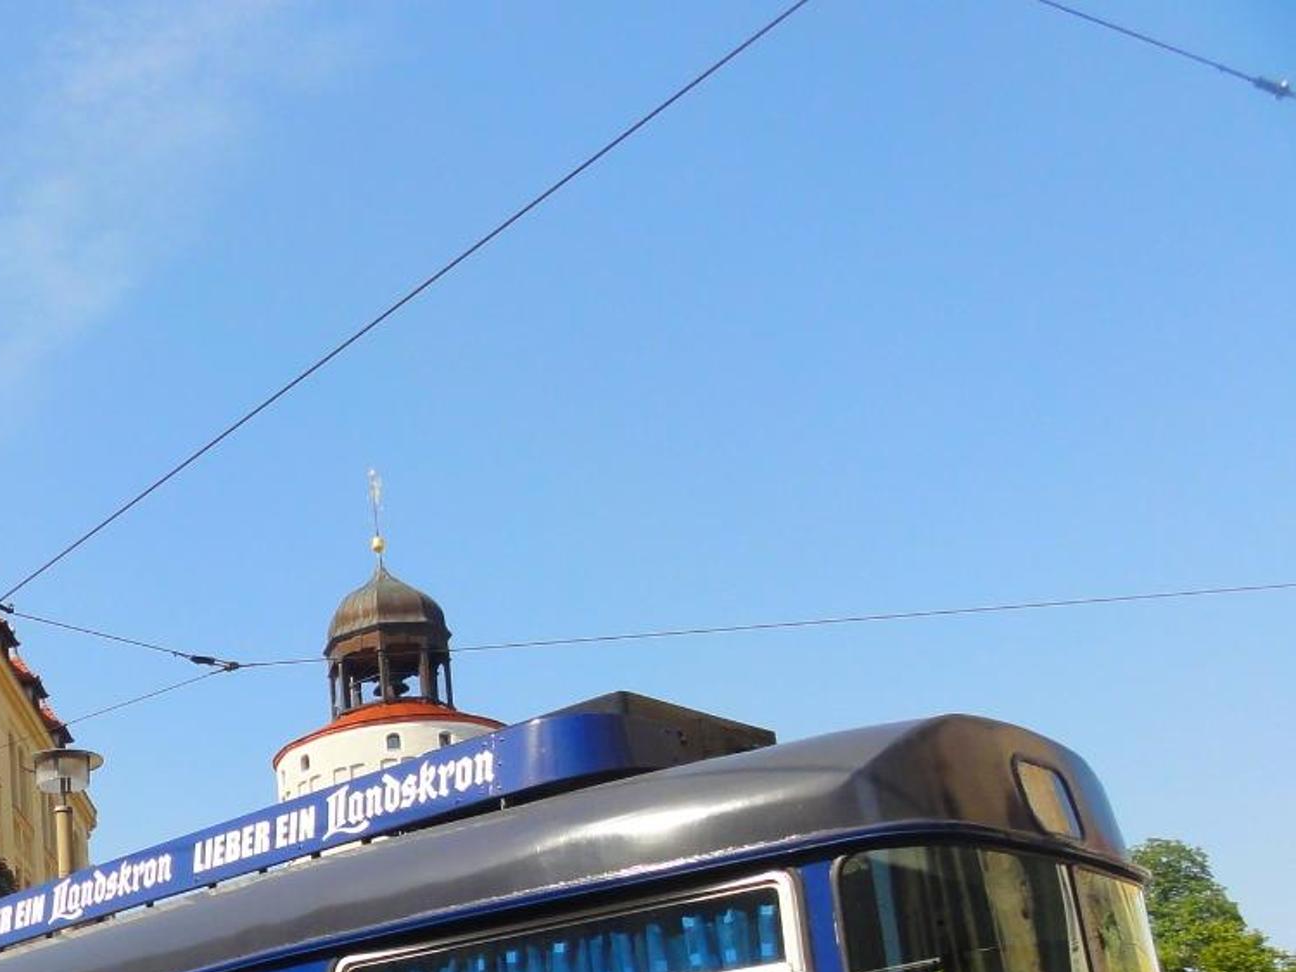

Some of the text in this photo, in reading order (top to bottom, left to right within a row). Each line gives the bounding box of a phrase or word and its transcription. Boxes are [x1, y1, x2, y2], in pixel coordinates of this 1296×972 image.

[193, 750, 494, 874] LIEBER EIN Landskron
[15, 894, 46, 932] EIN
[47, 853, 172, 925] Landskron
